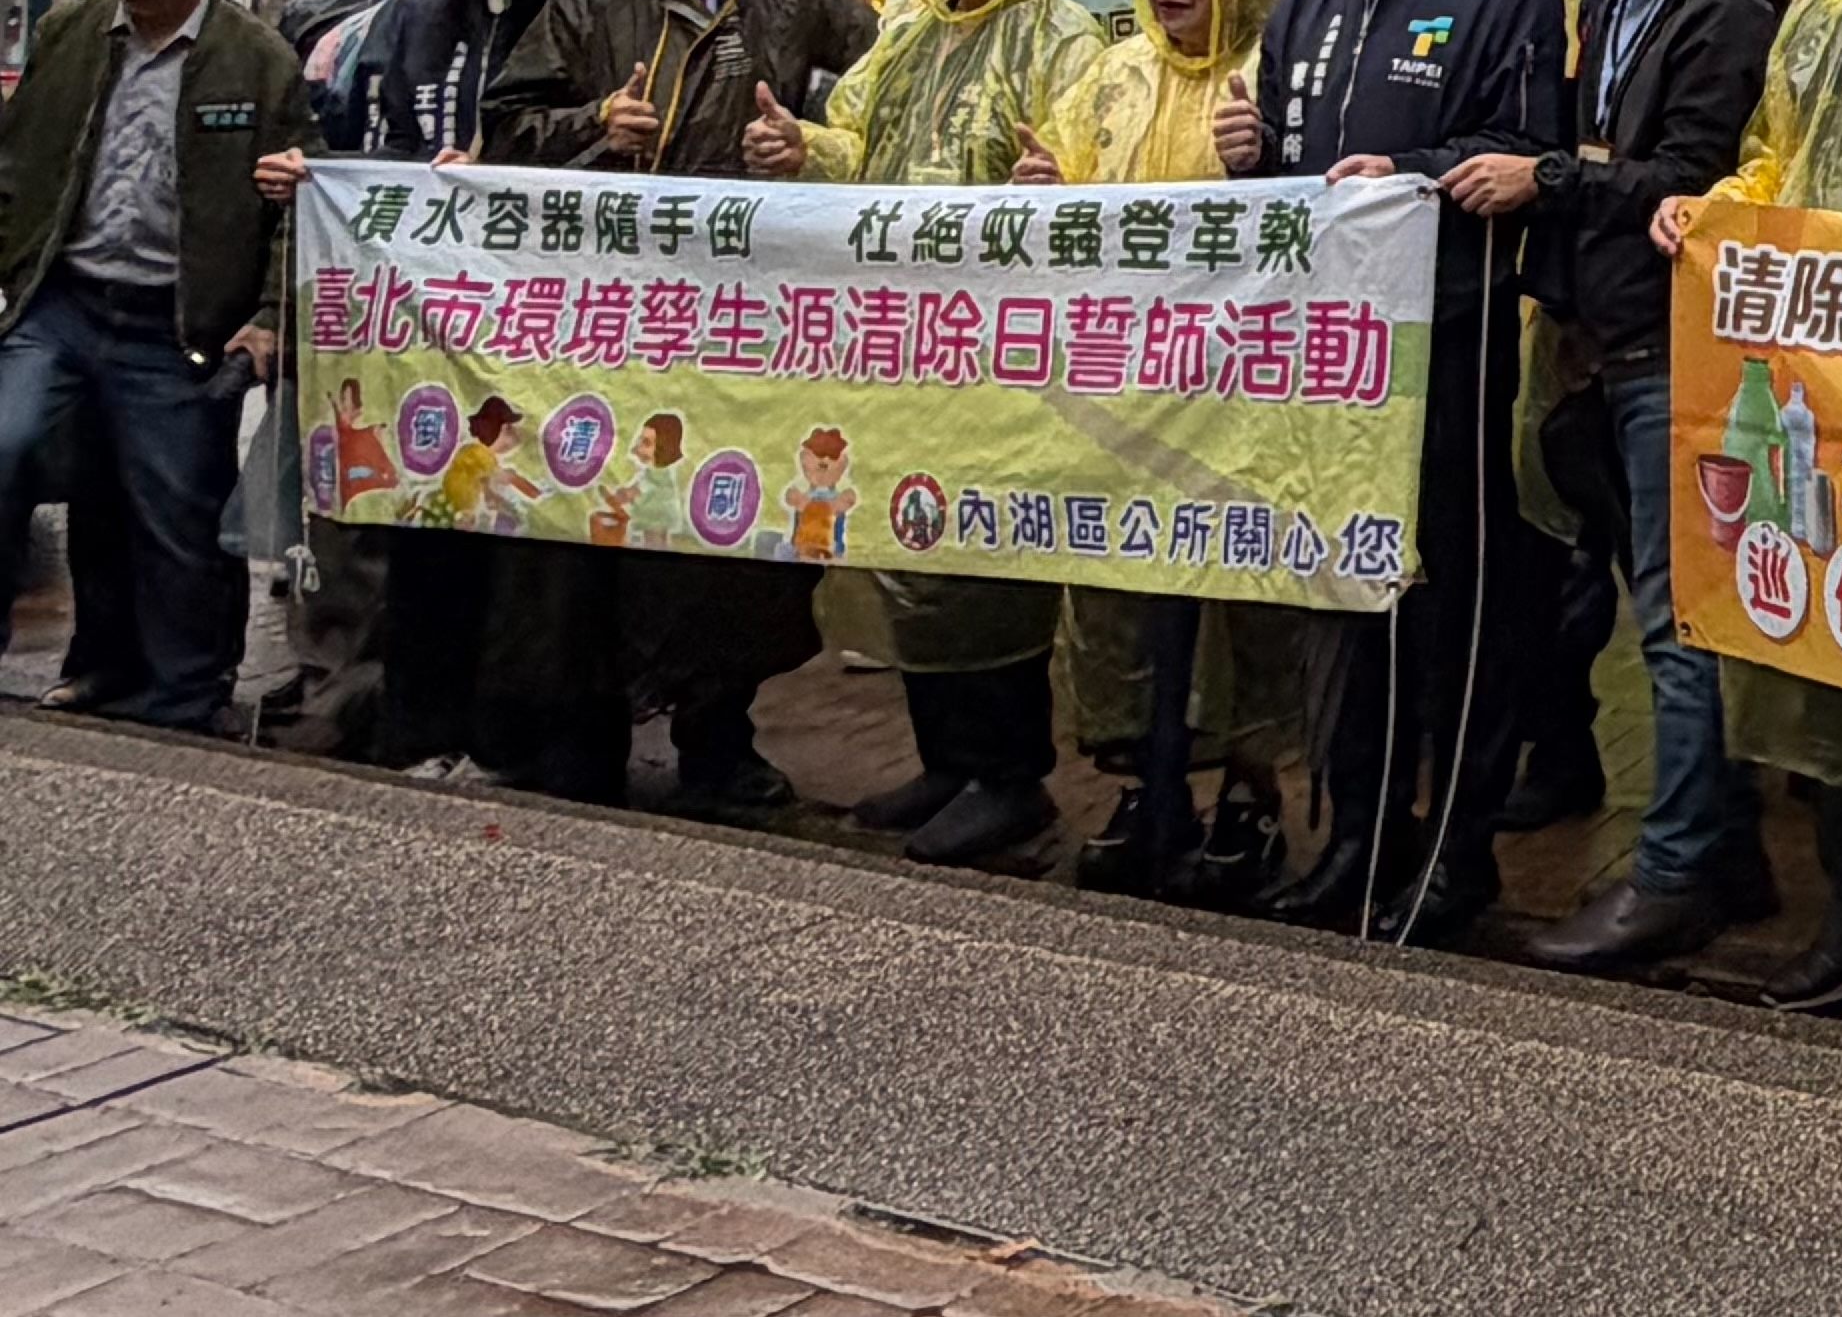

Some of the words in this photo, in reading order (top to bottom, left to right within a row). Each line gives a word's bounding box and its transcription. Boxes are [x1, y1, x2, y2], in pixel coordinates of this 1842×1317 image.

[1391, 57, 1443, 79] TAIPEI
[347, 183, 764, 259] 積水容器隨手倒
[848, 198, 1315, 274] 杜絕蚊蟲登革熱
[310, 263, 1390, 402] 臺北市環境孳生源清除日誓師活動
[559, 416, 600, 463] 清
[707, 472, 746, 520] 刷
[957, 488, 1402, 578] 內湖區公所關心您
[1747, 538, 1792, 620] 巡
